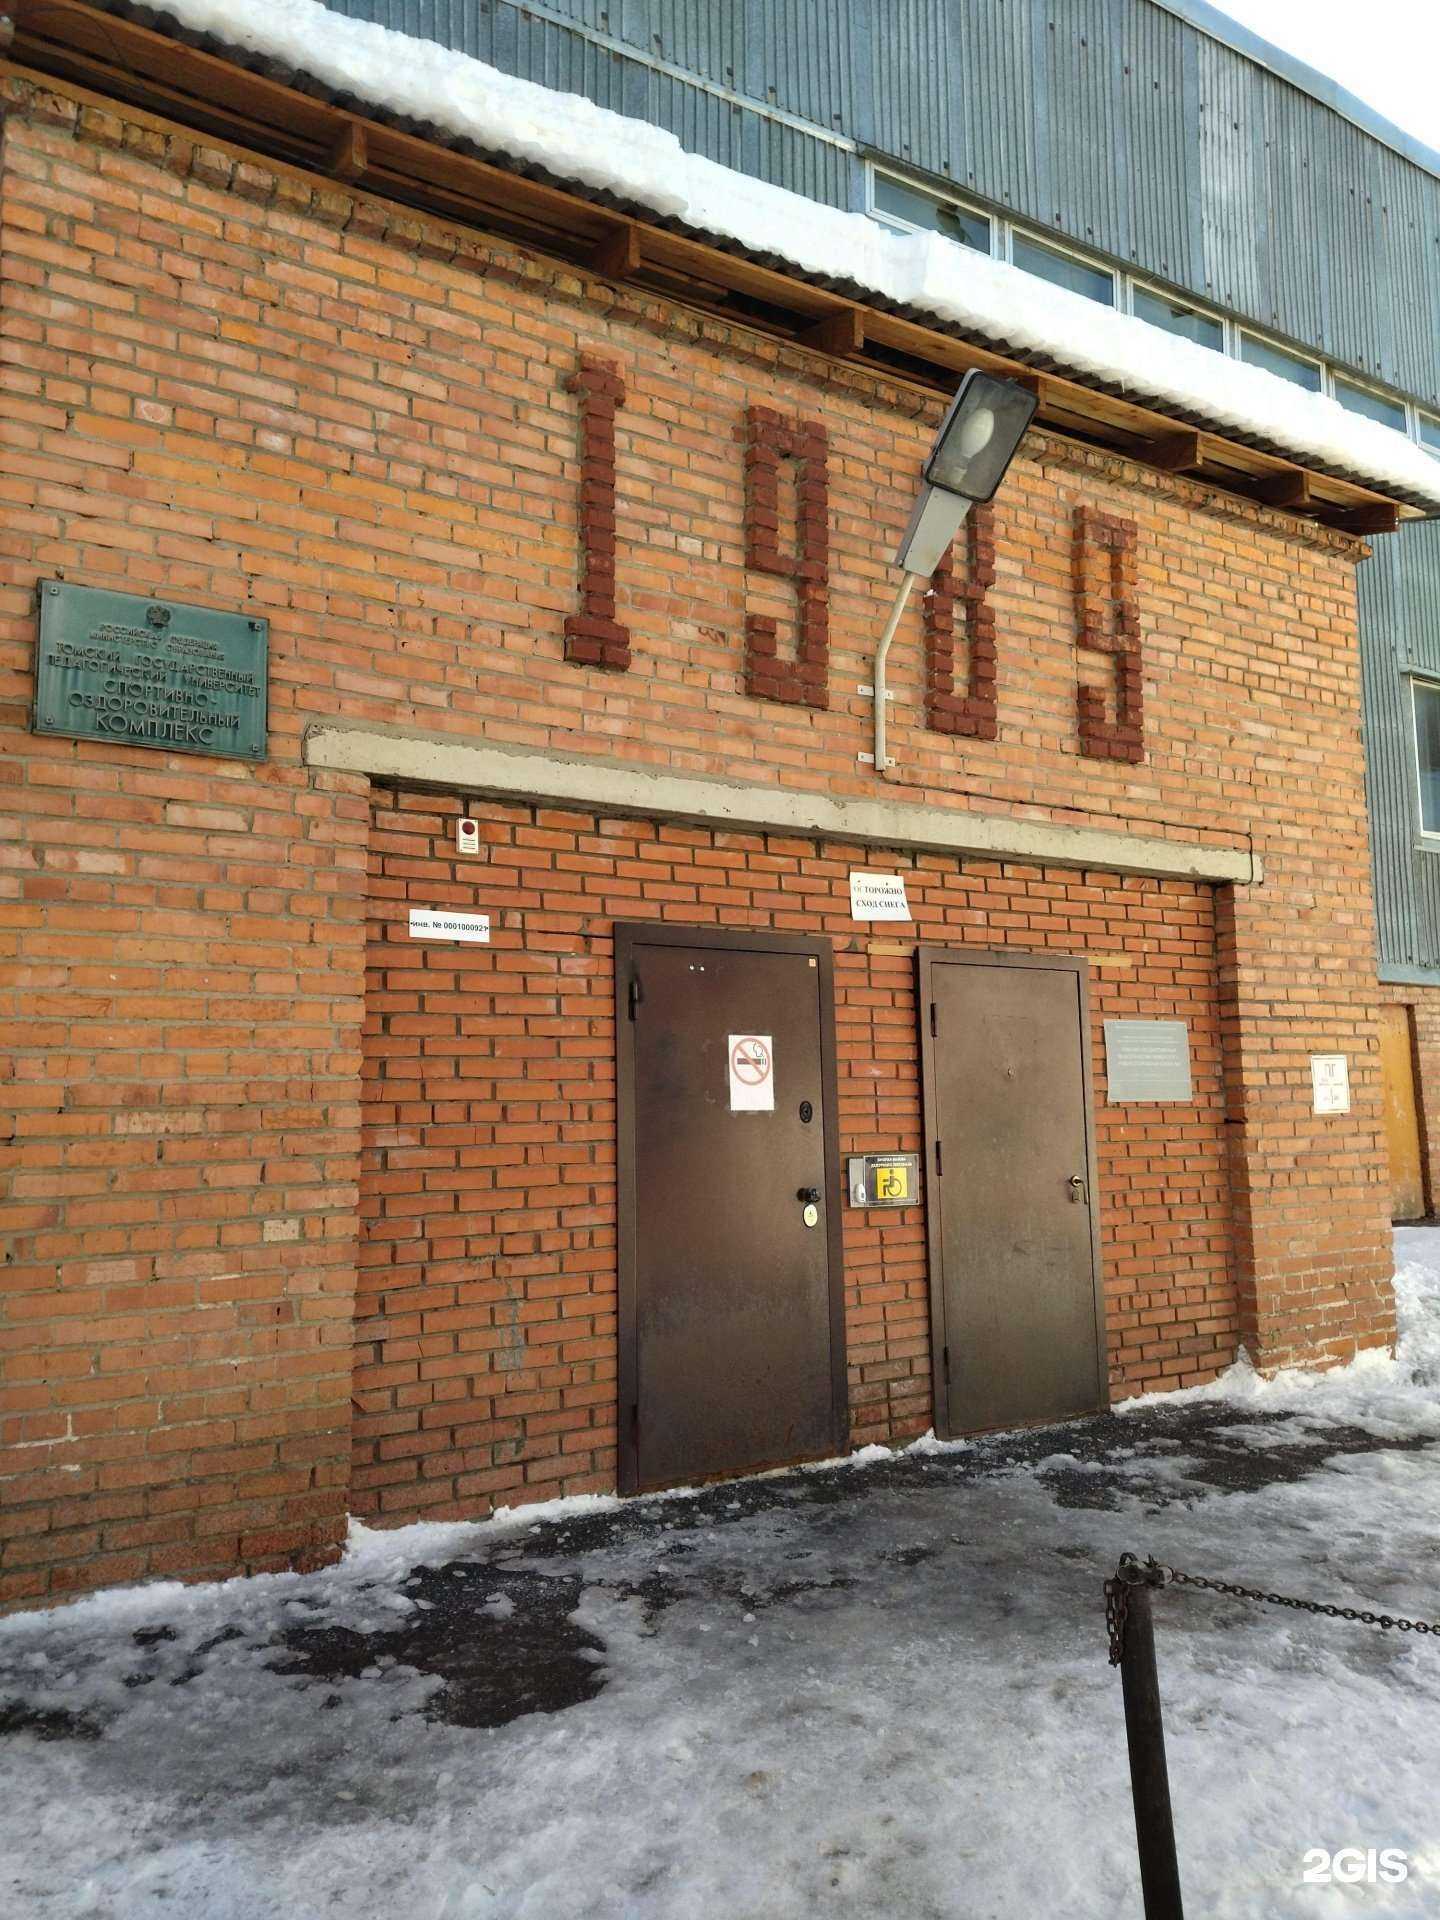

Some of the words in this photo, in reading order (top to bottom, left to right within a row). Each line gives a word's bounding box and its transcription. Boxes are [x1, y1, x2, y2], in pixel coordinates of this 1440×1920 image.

[48, 653, 167, 683] ПЕДАГОГИЧЕСКИЙ
[181, 674, 262, 698] УНИВЕРСИТЕТ
[56, 641, 121, 663] ТОМСКИЙ
[135, 654, 256, 685] ГОСУДАРСТВЕННЫЙ
[69, 692, 241, 729] ОЗДОРОВИТЕЛЬНЫЙ
[103, 680, 217, 707] СПОРТИВНО-
[96, 713, 216, 745] КОМПЛЕКС
